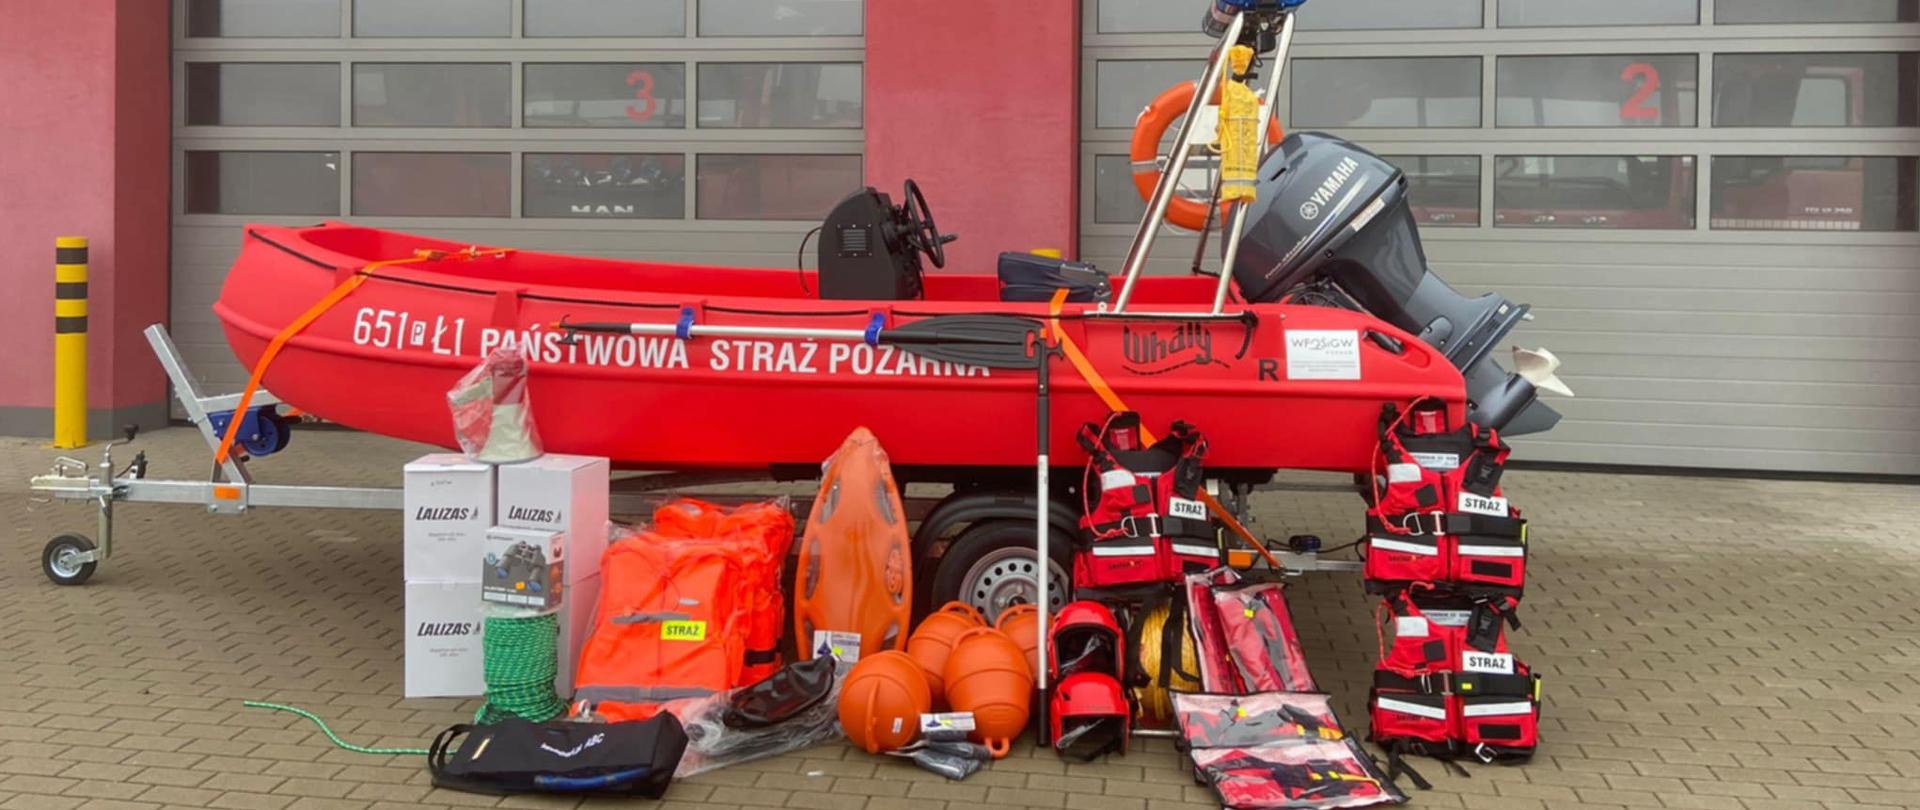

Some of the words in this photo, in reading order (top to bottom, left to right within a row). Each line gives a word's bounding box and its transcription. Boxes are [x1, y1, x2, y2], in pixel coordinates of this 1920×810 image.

[625, 69, 656, 122] 3
[1620, 63, 1660, 119] 2
[1310, 156, 1359, 206] YAMAHA
[353, 307, 409, 349] 651
[481, 324, 689, 368] PAŃSTWOWA
[710, 338, 818, 373] STRAŻ
[1258, 359, 1278, 381] R
[416, 506, 469, 520] LALIZAS
[508, 505, 554, 522] LALIZAS
[417, 622, 471, 636] LALIZAS
